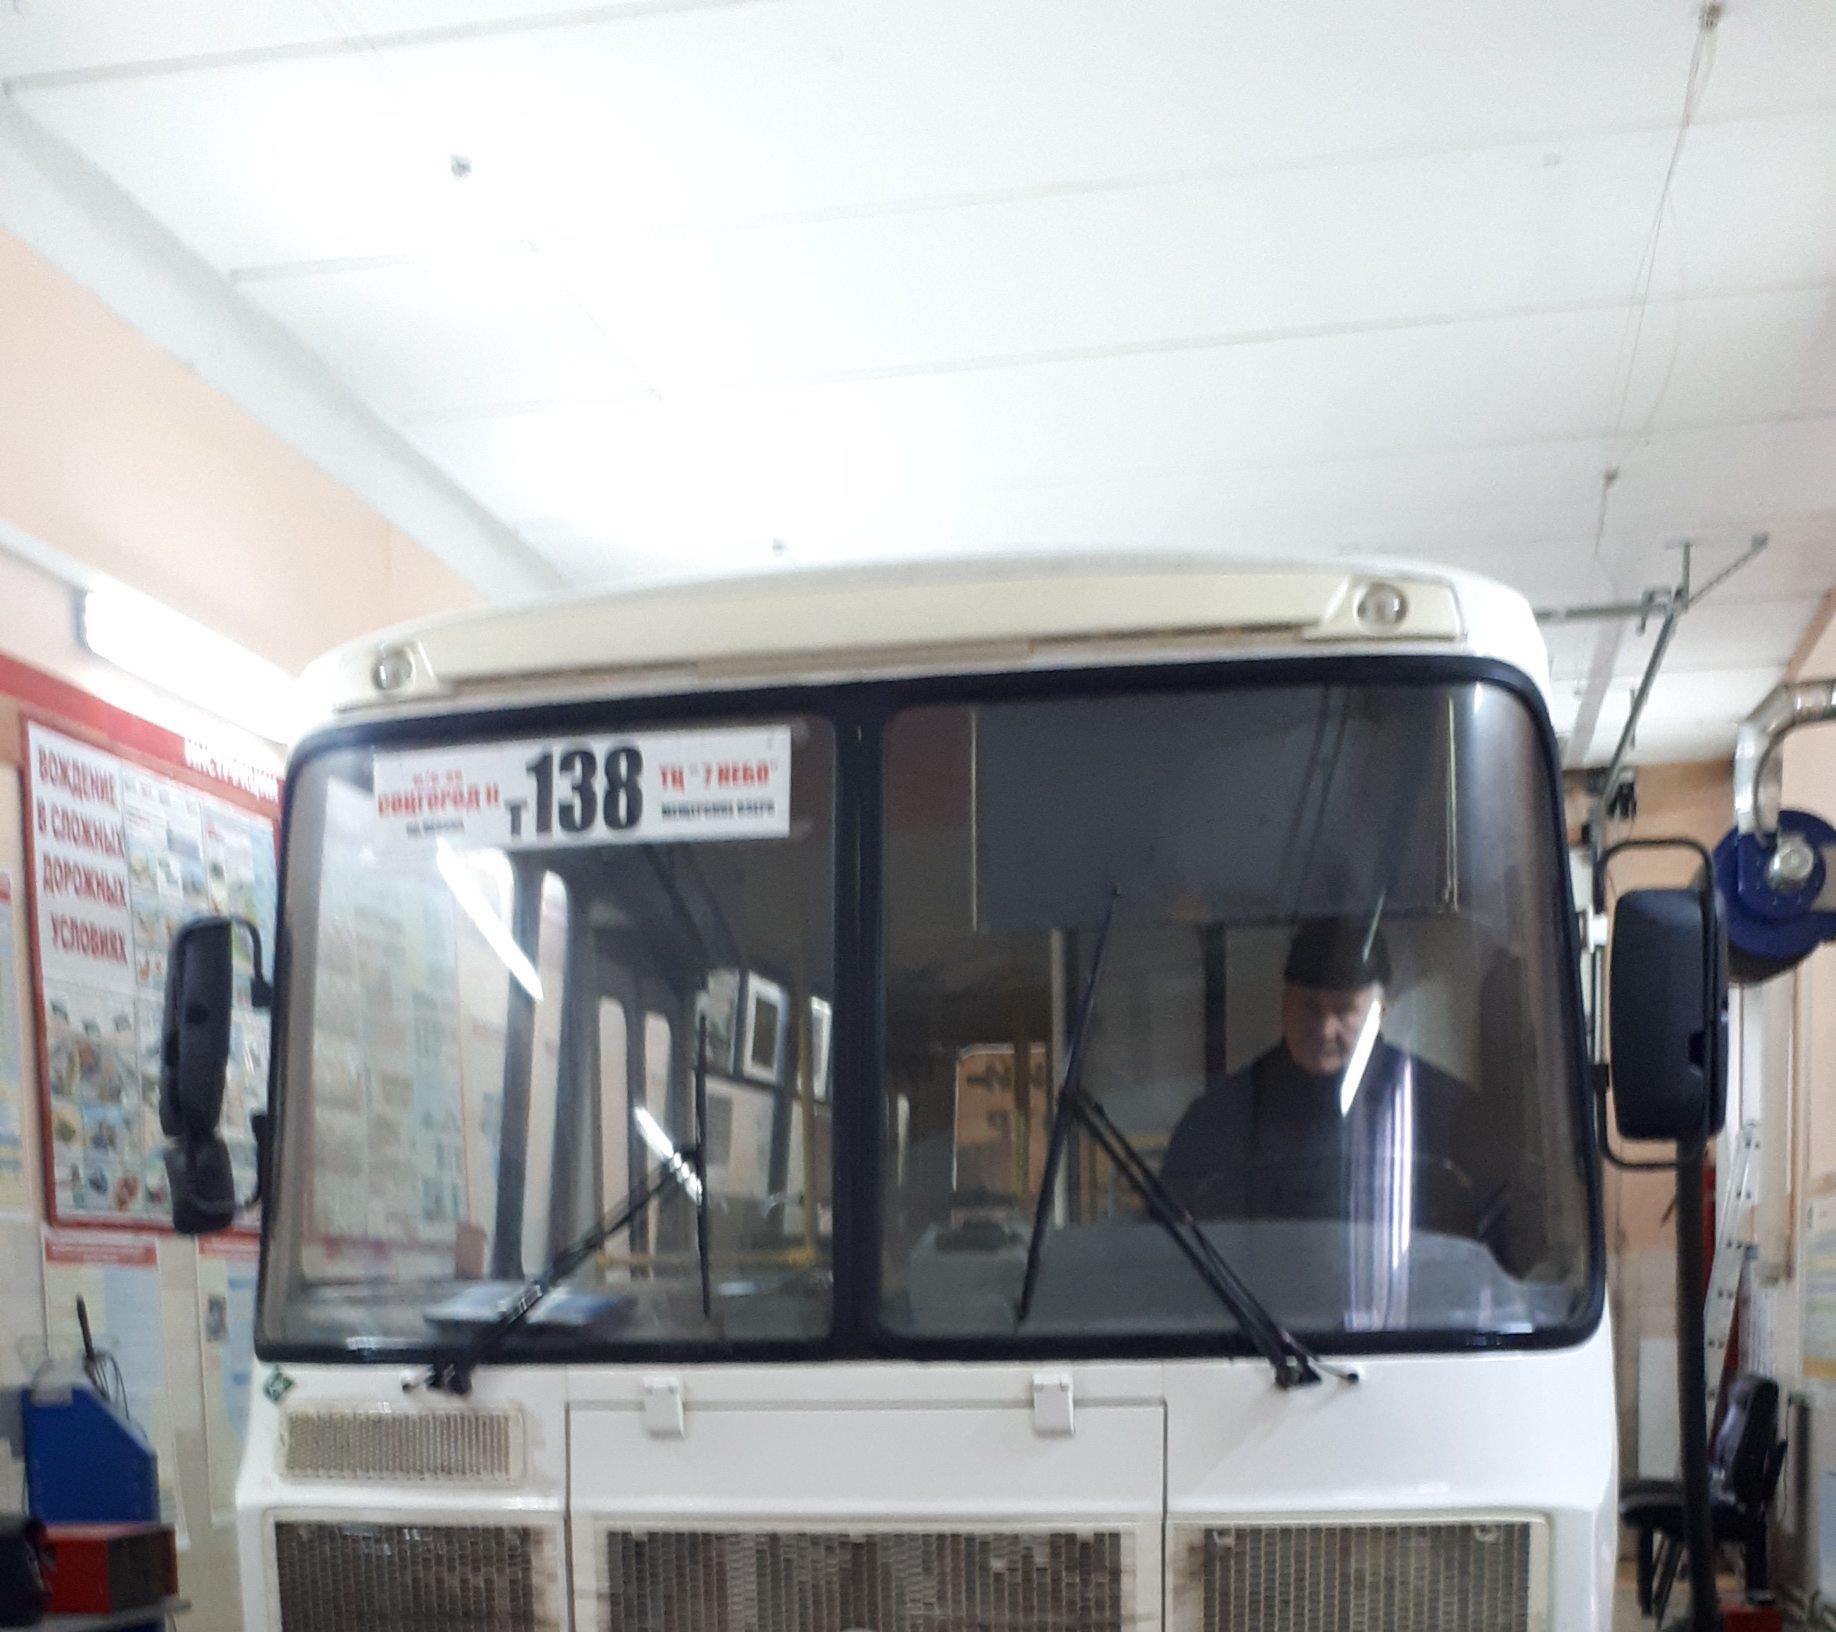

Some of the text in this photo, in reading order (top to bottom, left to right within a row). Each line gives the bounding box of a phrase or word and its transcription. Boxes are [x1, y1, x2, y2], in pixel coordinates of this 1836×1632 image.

[38, 744, 117, 808] ВОЖДЕНИЕ
[51, 803, 125, 859] СЛОЖНЫХ
[43, 851, 127, 908] ДОРОЖНЫХ
